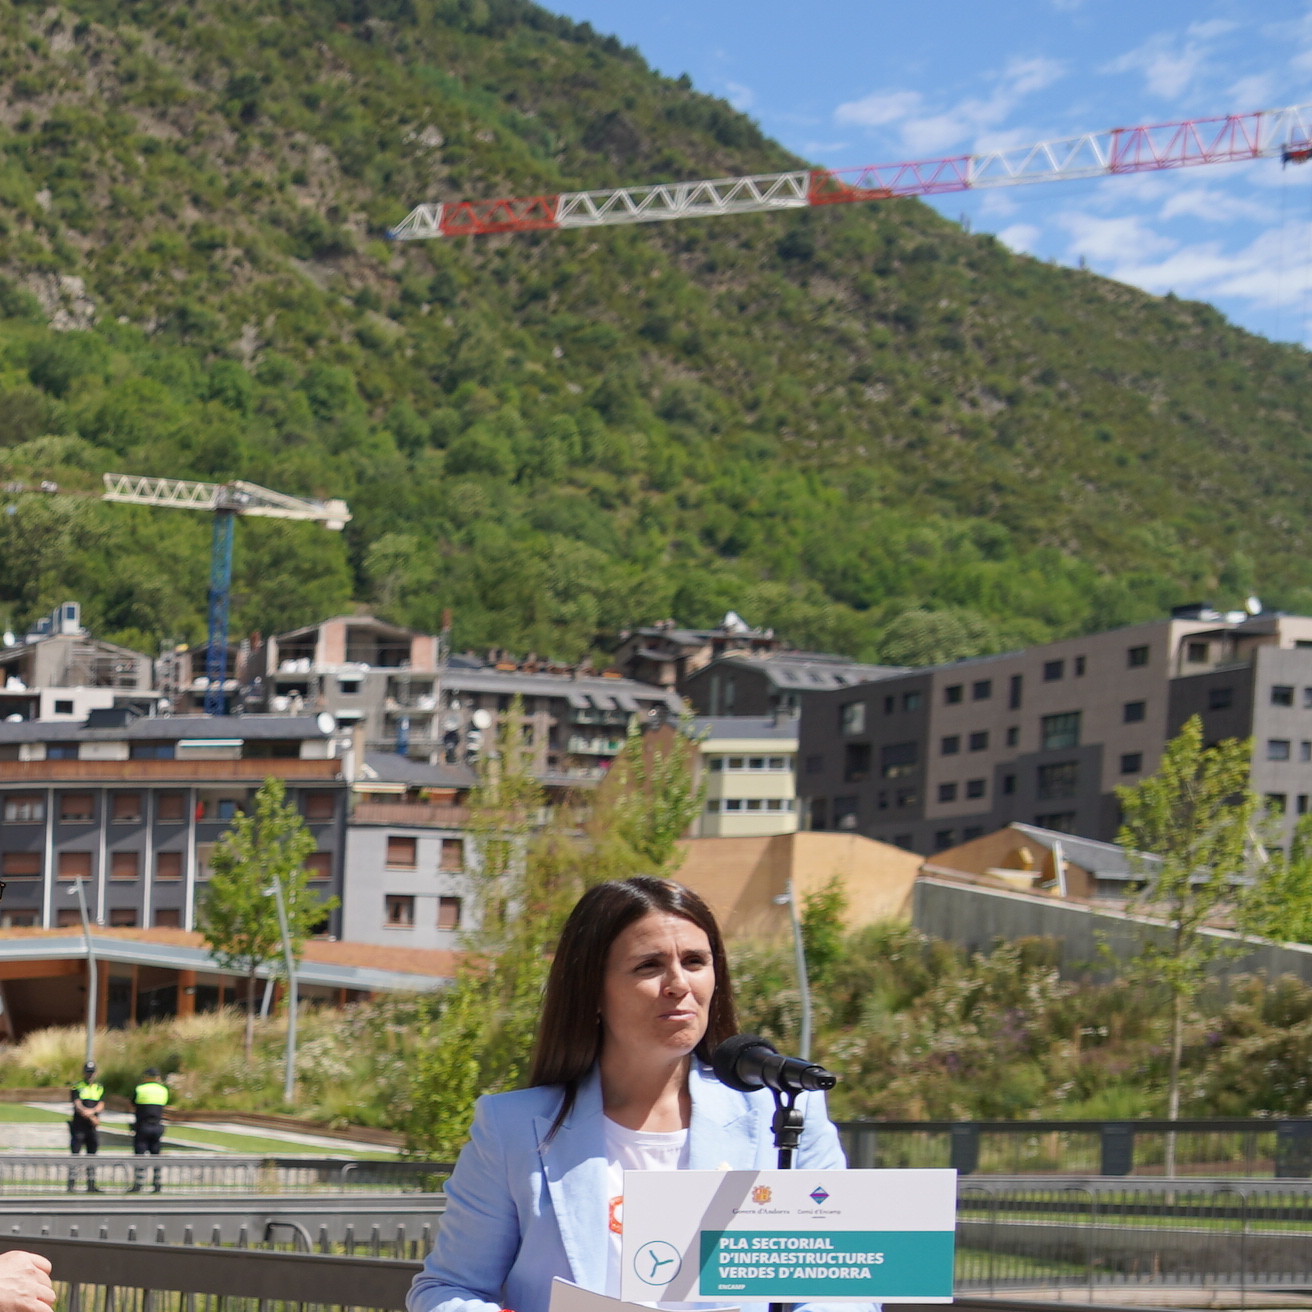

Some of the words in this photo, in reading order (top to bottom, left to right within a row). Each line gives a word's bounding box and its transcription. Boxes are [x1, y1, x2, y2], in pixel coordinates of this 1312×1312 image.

[719, 1238, 748, 1249] PLA
[752, 1238, 834, 1249] SECTORIAL
[719, 1253, 884, 1264] D'INFRAESTRUCTURES
[719, 1267, 775, 1278] VERDES
[778, 1267, 871, 1278] D'ANDORRA
